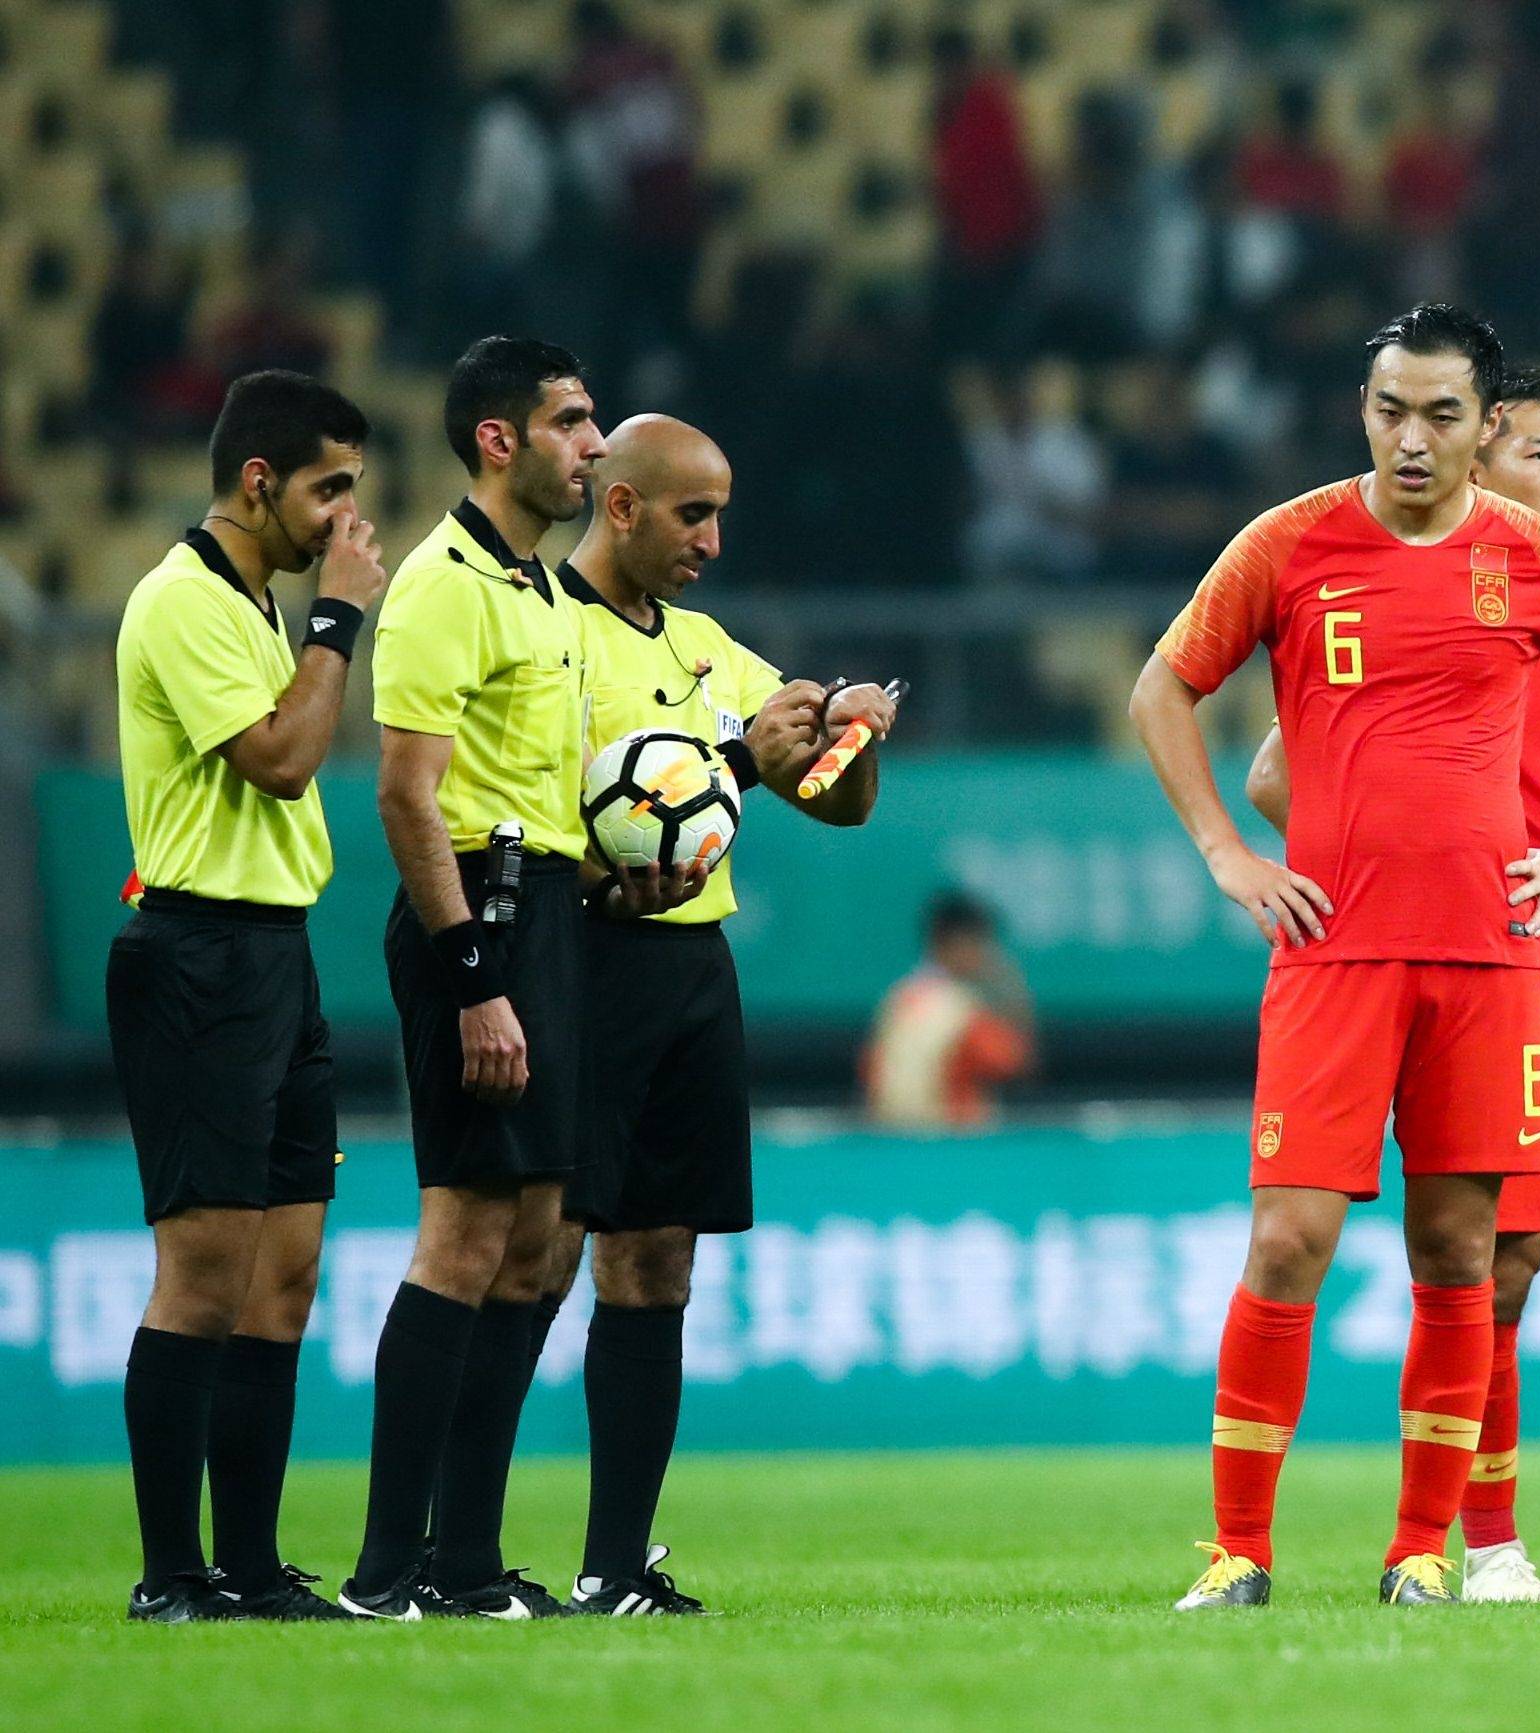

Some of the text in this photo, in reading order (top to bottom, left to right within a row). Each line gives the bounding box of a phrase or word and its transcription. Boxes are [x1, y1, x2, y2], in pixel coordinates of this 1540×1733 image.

[1475, 574, 1505, 588] CFA
[1324, 611, 1363, 684] 6
[723, 714, 742, 739] FIFA
